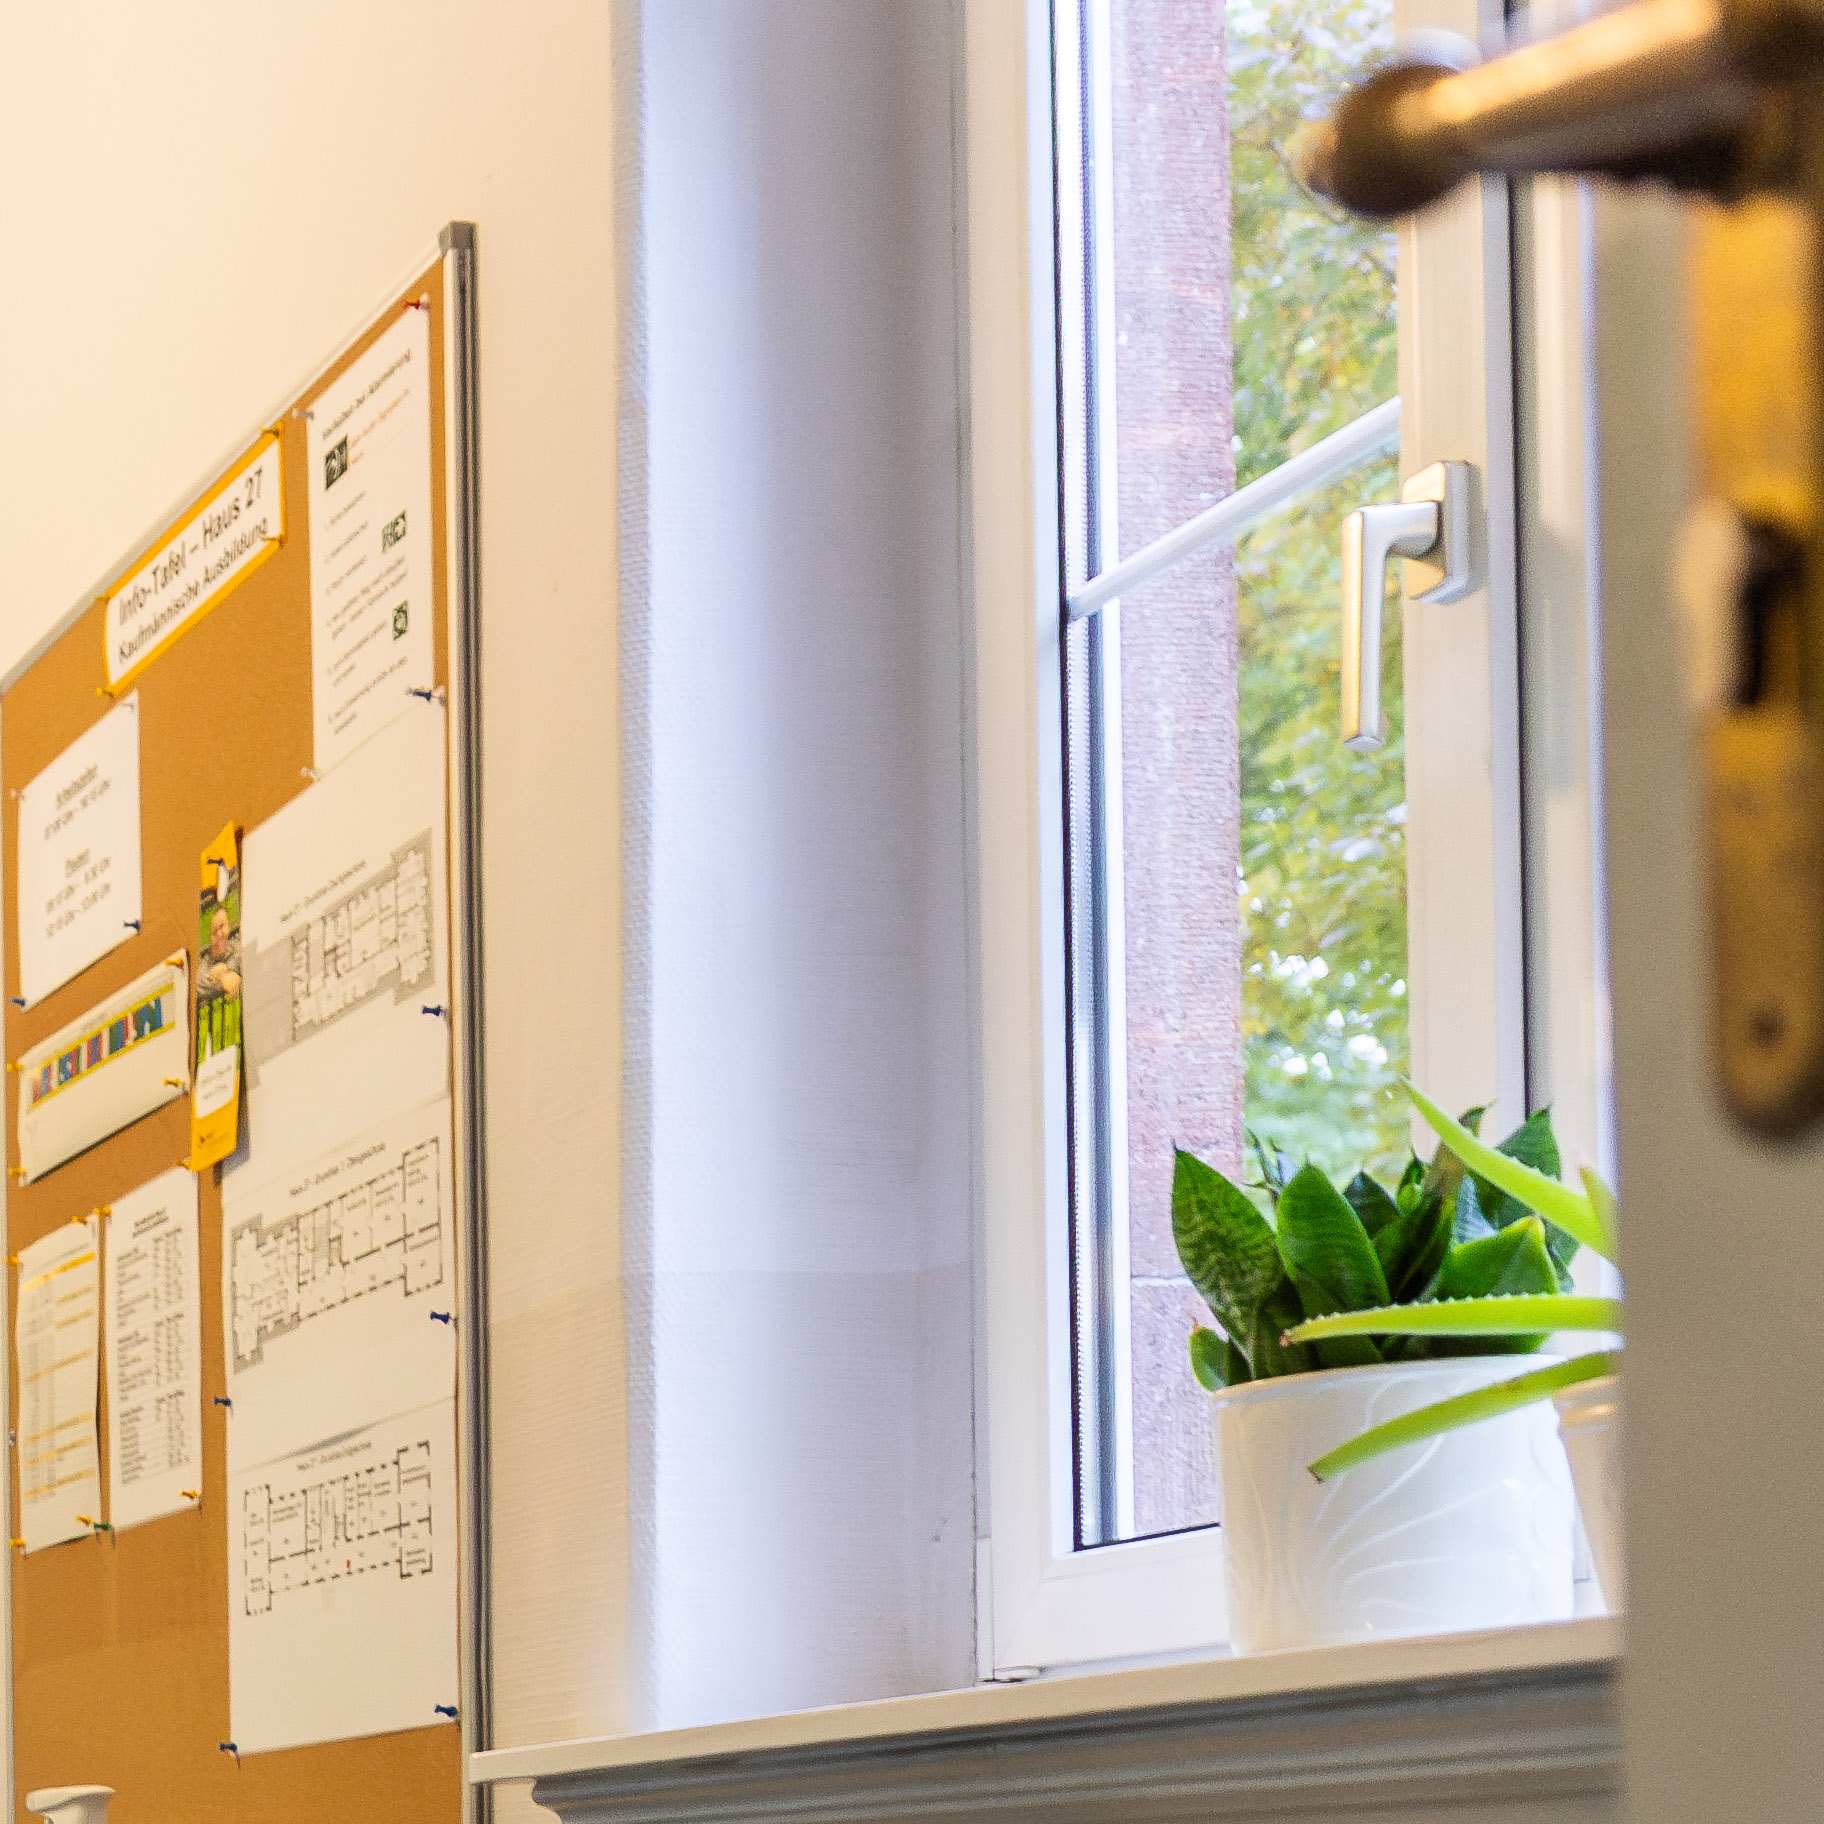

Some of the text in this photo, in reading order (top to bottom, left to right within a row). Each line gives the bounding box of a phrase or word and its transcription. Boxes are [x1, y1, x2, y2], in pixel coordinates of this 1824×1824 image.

[201, 497, 241, 550] Haus
[244, 466, 263, 509] 27
[203, 517, 269, 588] Ausbildung
